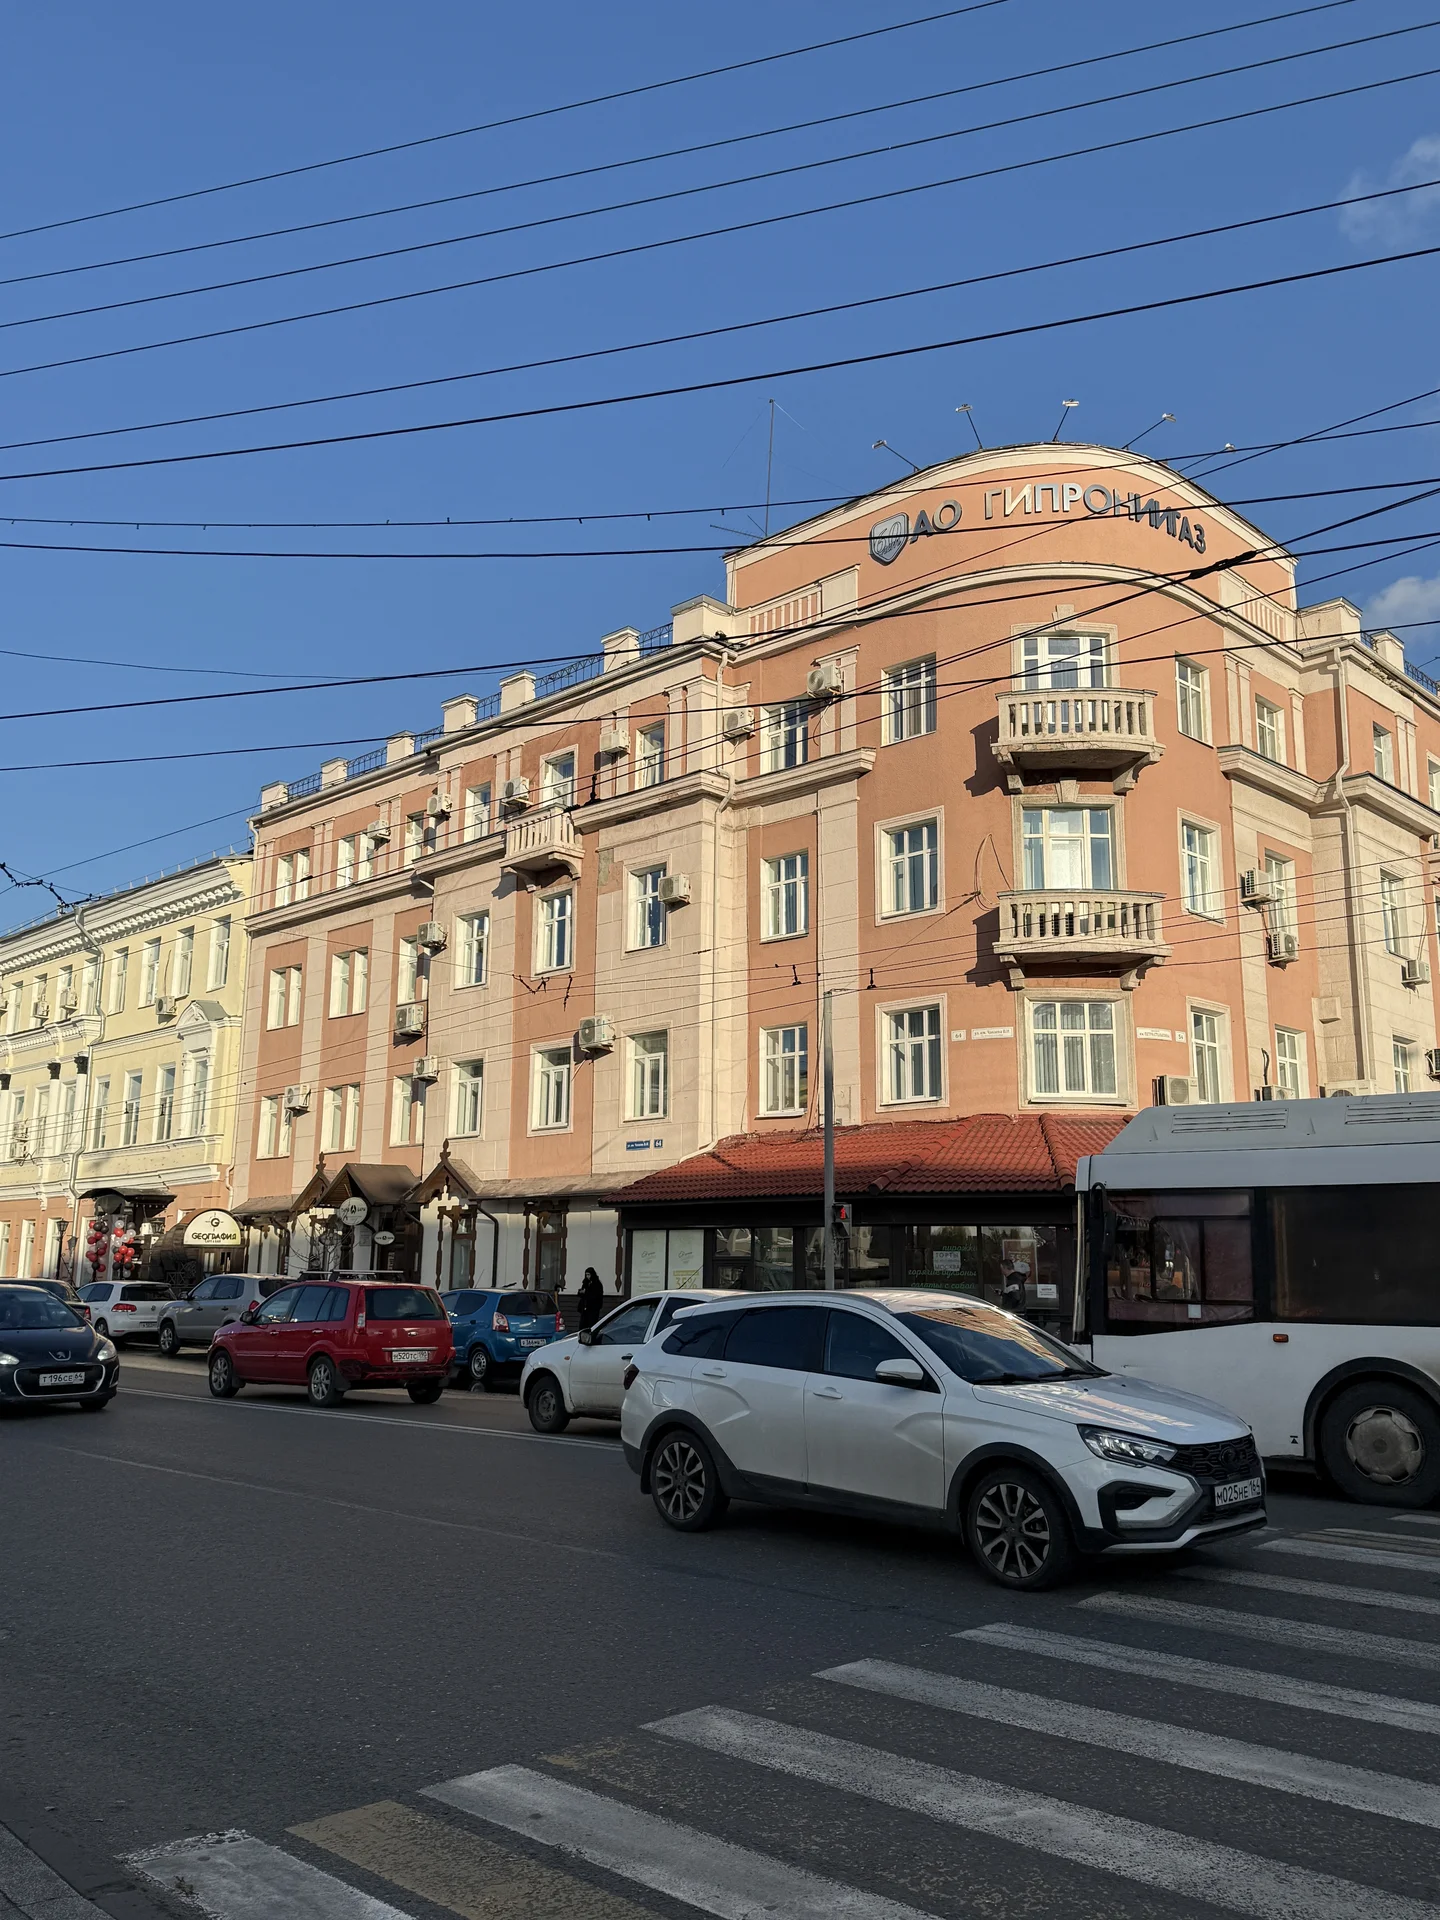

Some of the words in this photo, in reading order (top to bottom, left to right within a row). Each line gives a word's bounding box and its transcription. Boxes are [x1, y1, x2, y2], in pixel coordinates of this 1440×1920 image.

[909, 499, 962, 544] АО
[43, 1374, 73, 1383] Т196СЕ
[1216, 1484, 1248, 1504] М025НЕ
